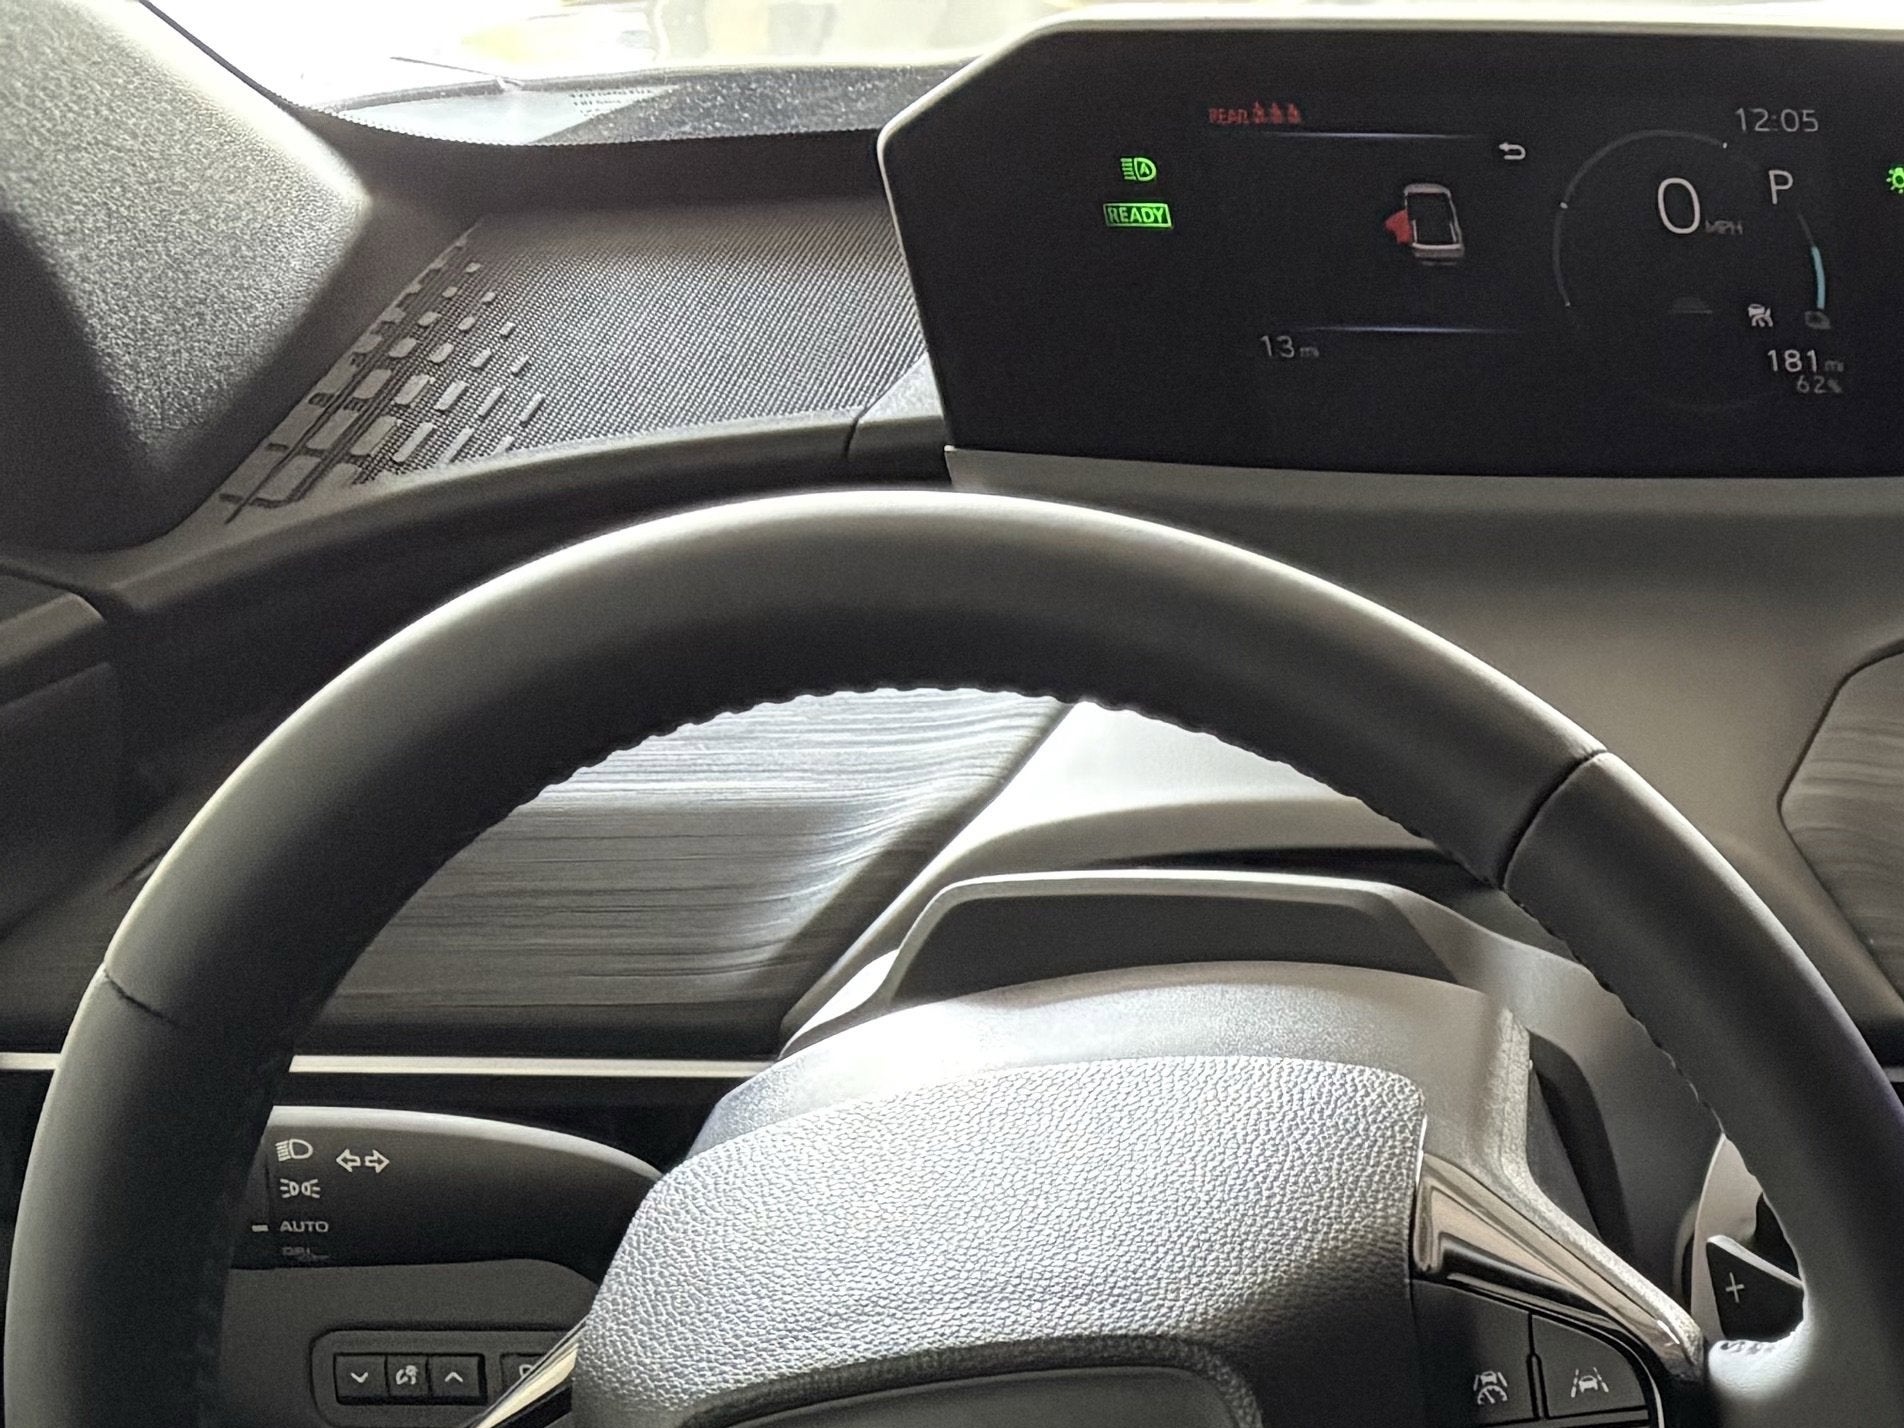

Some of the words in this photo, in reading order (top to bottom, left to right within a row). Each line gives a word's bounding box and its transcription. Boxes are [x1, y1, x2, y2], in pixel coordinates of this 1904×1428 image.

[1735, 107, 1819, 132] 12:05
[1767, 169, 1794, 204] P
[1107, 206, 1164, 223] READY
[1657, 177, 1701, 234] 0
[1260, 335, 1295, 359] 13
[1767, 349, 1819, 373] 181
[280, 1220, 329, 1233] AUTO
